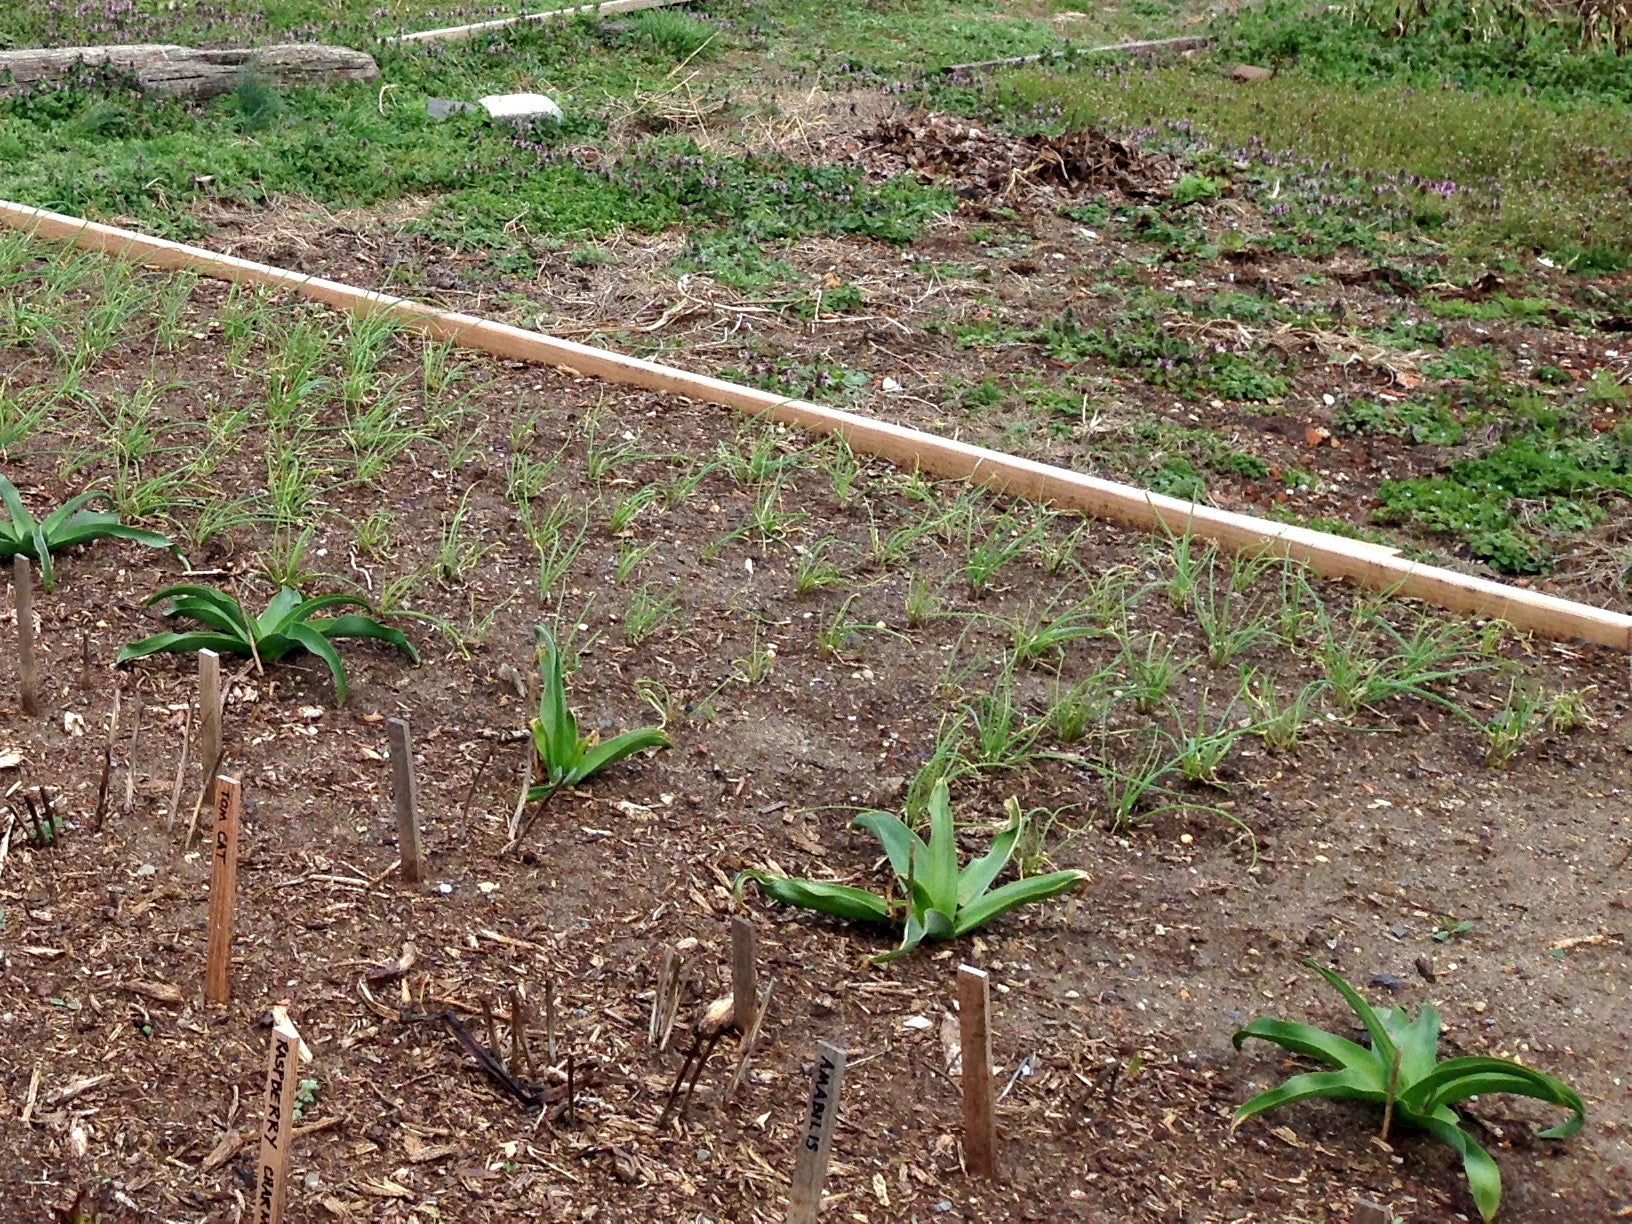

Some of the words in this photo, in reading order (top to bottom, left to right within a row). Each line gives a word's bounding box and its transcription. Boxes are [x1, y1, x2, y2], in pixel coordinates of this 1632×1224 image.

[218, 791, 230, 822] TOM
[215, 830, 228, 866] CAT
[263, 1038, 290, 1151] RASPBERRY
[805, 1055, 835, 1153] AMABILIS
